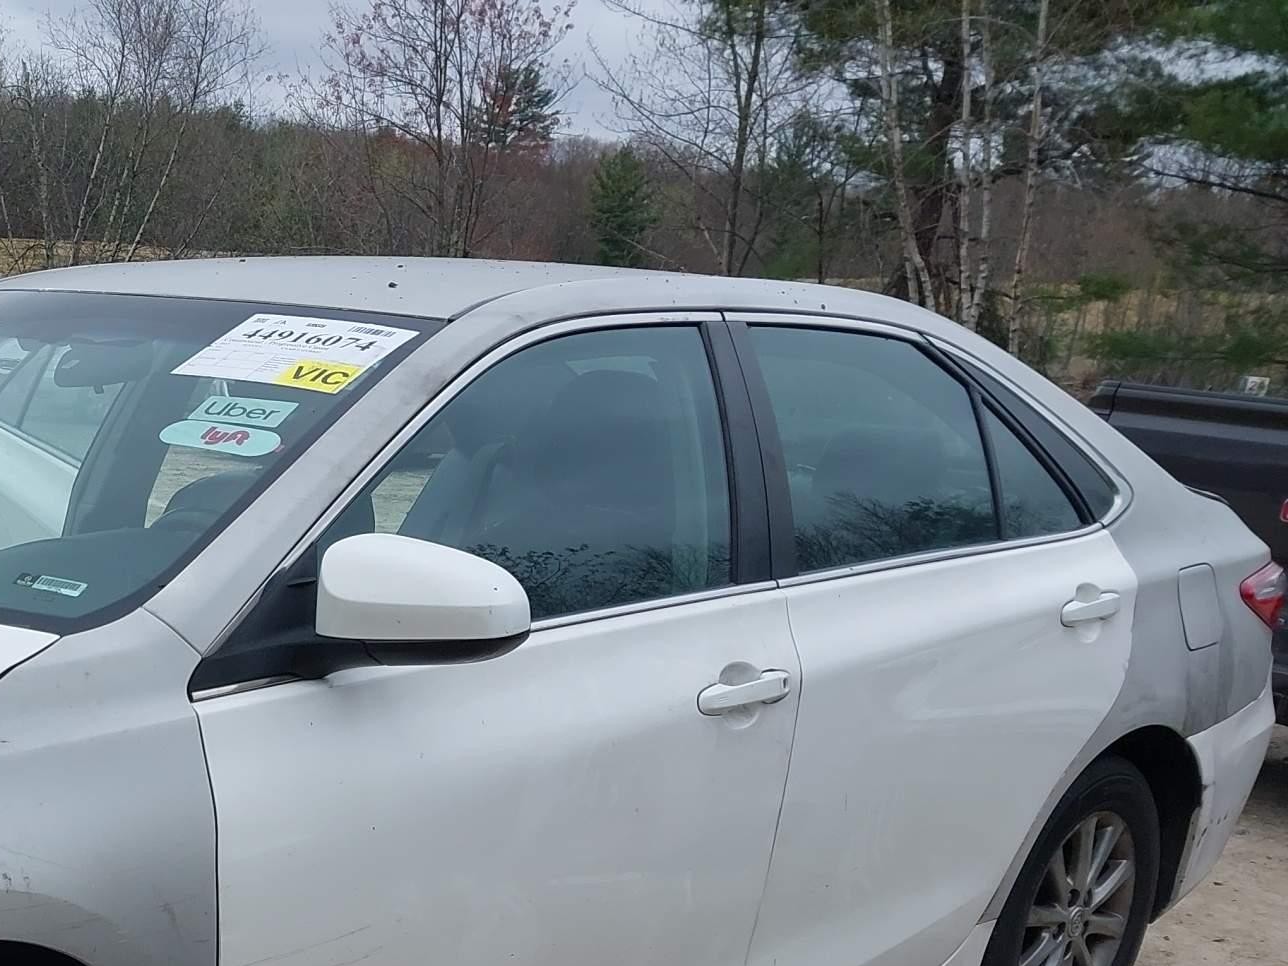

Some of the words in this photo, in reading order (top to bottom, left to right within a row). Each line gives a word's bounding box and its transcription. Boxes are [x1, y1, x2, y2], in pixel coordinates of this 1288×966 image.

[242, 327, 377, 352] 44916074
[291, 365, 349, 386] VIC
[204, 401, 280, 420] Uber
[200, 426, 250, 446] lyft
